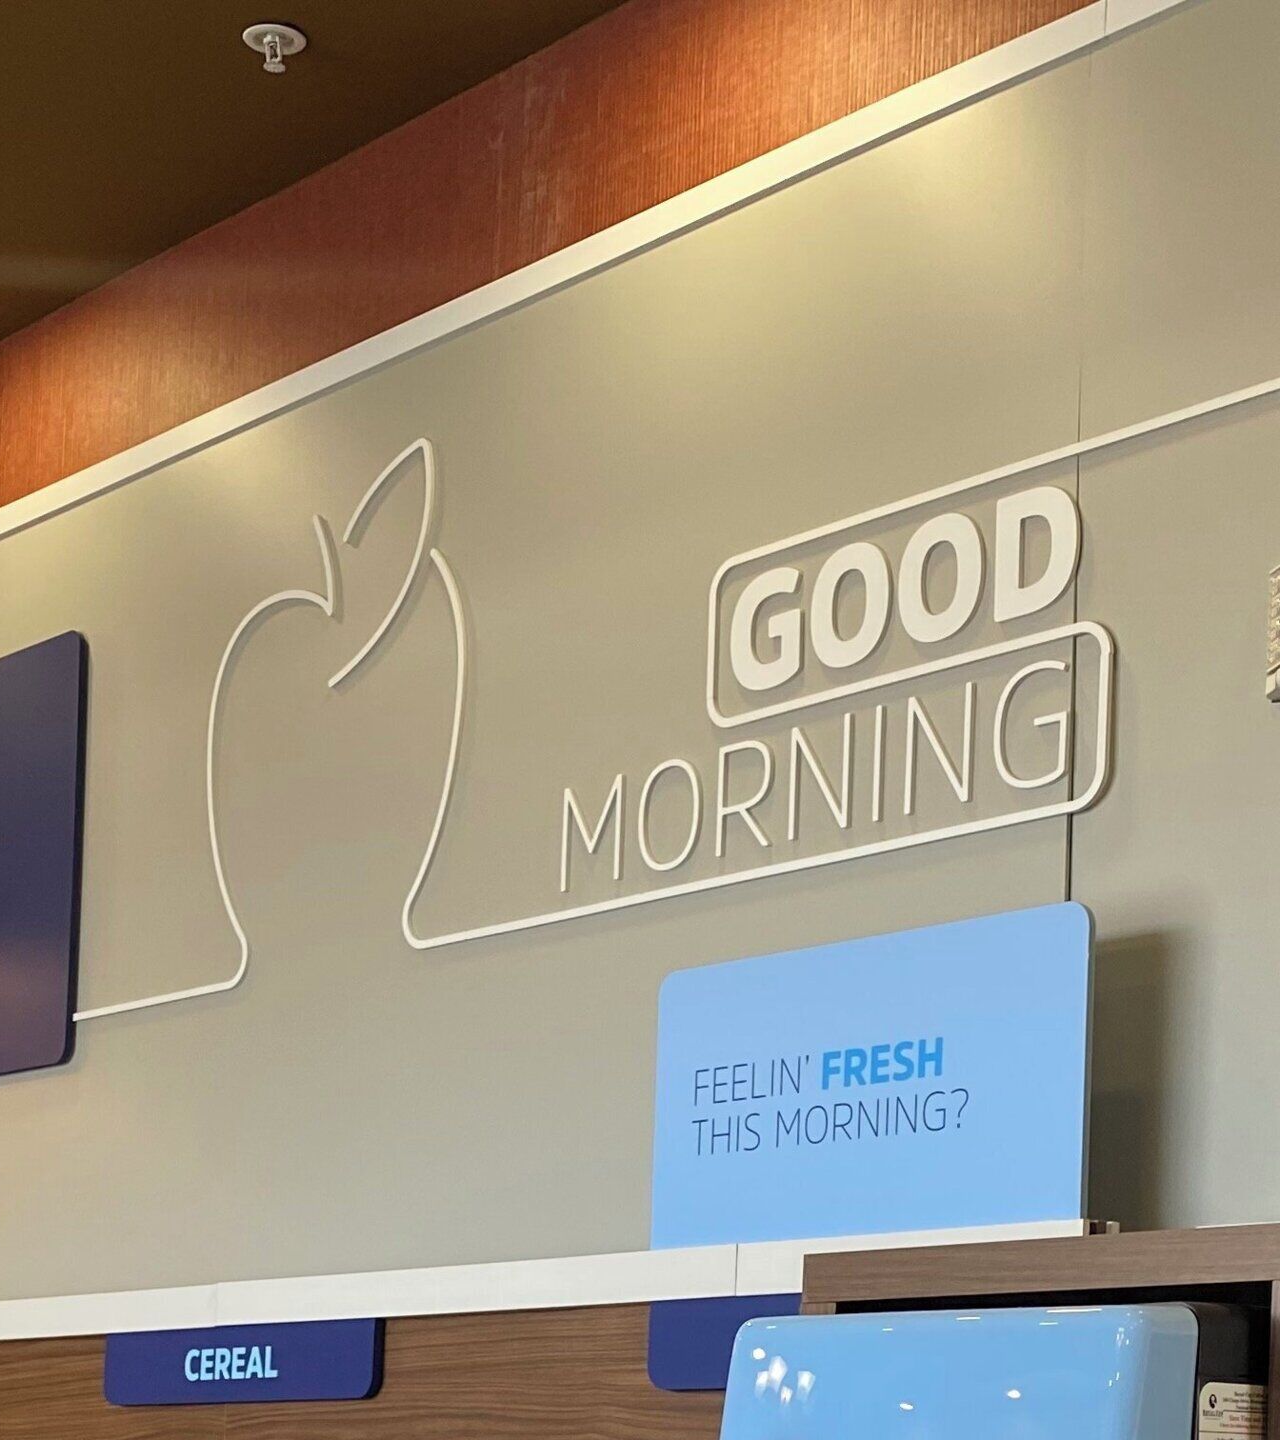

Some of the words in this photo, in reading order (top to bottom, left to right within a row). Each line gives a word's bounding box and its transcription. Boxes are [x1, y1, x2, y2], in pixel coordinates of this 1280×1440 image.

[730, 486, 1081, 691] GOOD
[559, 660, 1070, 893] MORNING
[693, 1054, 810, 1106] FEELIN'
[821, 1036, 943, 1090] FRESH
[692, 1112, 760, 1156] THIS
[776, 1087, 969, 1148] MORNING?
[184, 1346, 278, 1382] CEREAL
